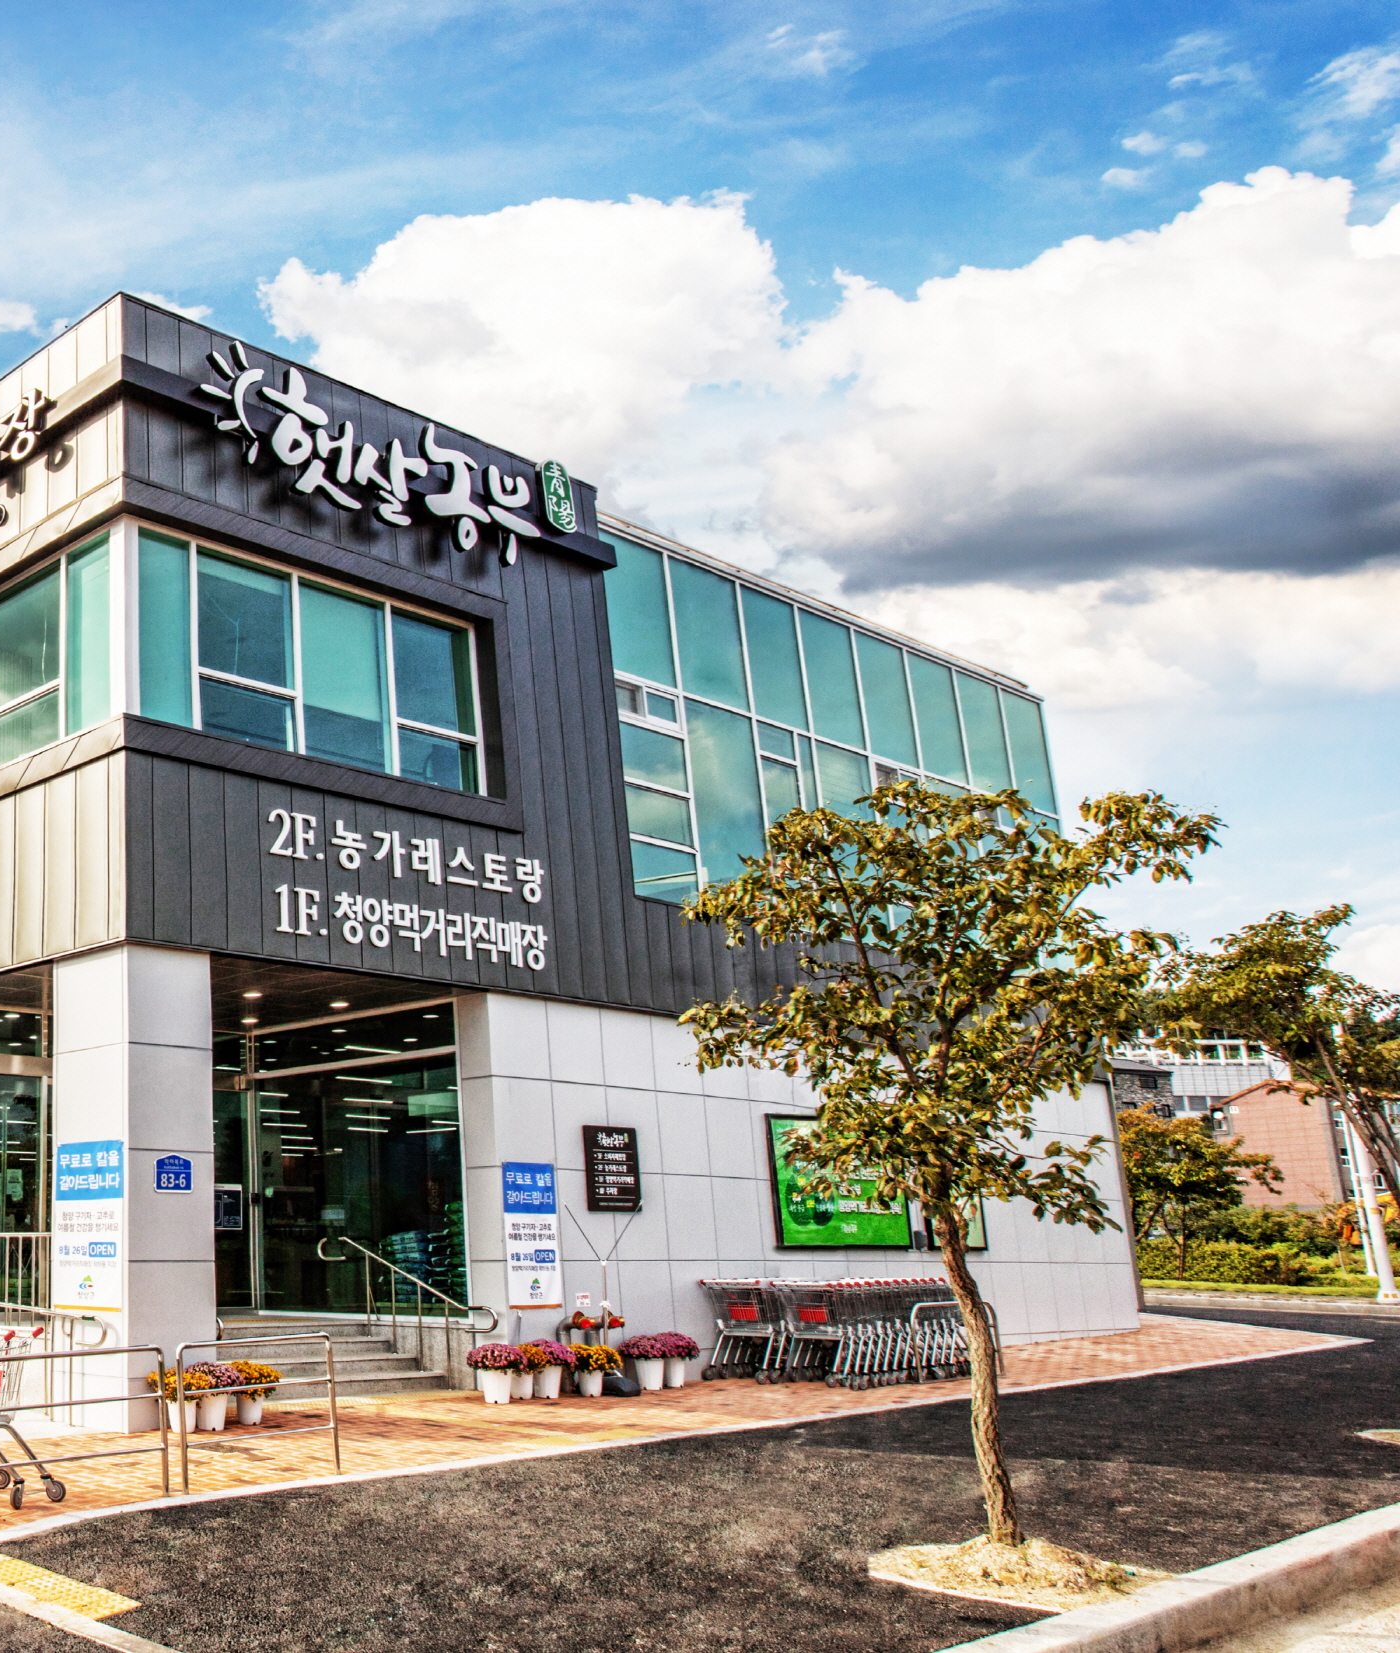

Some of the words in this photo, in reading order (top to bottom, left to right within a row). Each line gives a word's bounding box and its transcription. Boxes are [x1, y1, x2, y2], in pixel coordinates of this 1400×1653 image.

[259, 366, 542, 567] 햇살농부
[268, 808, 324, 860] 2F.
[331, 820, 544, 904] 농가레스토랑
[275, 884, 328, 936] 1F.
[333, 891, 548, 971] 청양먹거리직매장
[59, 1153, 93, 1170] 무료로
[96, 1150, 120, 1167] 칼을
[59, 1172, 121, 1191] 갈아드립니다
[160, 1173, 187, 1188] 83-6
[505, 1171, 533, 1185] 무료로
[535, 1173, 553, 1187] 칼을
[506, 1190, 554, 1205] 갈아드립니다
[62, 1211, 74, 1222] 청양
[96, 1210, 116, 1220] 고추로
[57, 1222, 75, 1233] 여름철
[76, 1222, 94, 1233] 건강을
[95, 1222, 119, 1233] 챙기세요
[539, 1222, 552, 1231] 고추로
[58, 1245, 70, 1256] 8월
[72, 1245, 88, 1256] 26일
[89, 1244, 115, 1256] OPEN
[510, 1252, 522, 1262] 8월
[522, 1252, 534, 1262] 26일
[535, 1251, 555, 1262] OPEN
